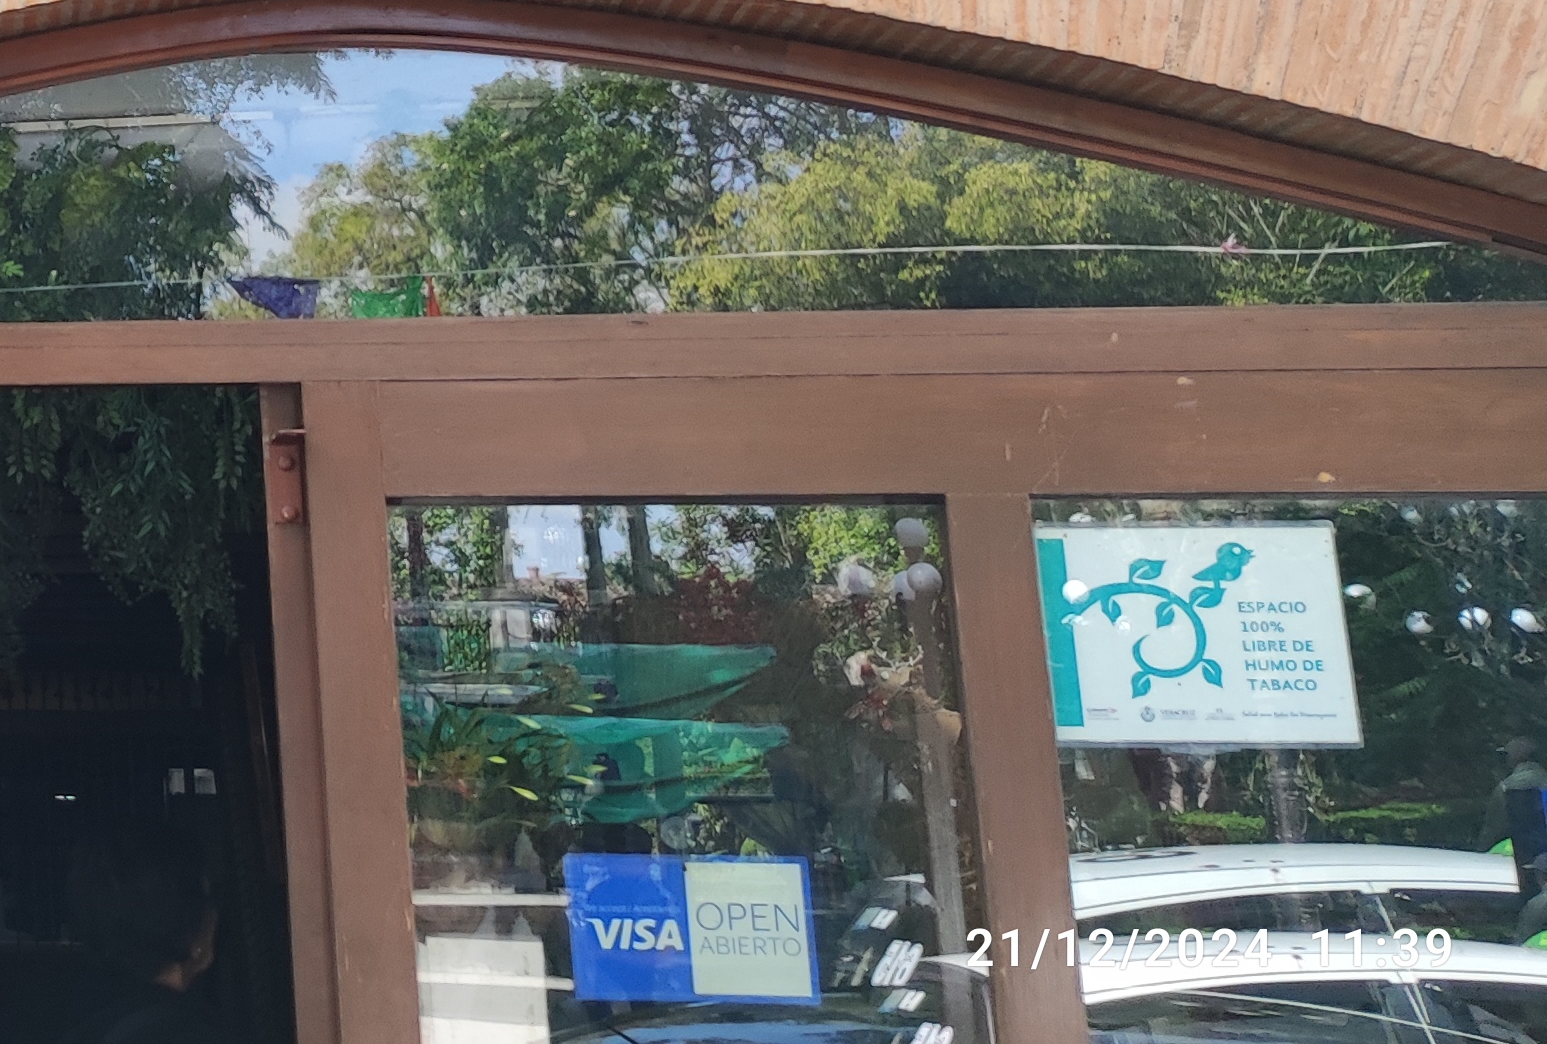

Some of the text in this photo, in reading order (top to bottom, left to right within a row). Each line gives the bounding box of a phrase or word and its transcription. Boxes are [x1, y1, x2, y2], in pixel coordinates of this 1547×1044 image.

[1237, 601, 1307, 613] ESPACIO
[1240, 620, 1285, 633] 100%
[1242, 640, 1315, 652] LIBRE DE
[1244, 659, 1324, 672] HUMO DE
[1246, 678, 1318, 691] TABACO
[695, 901, 800, 933] OPEN
[585, 917, 684, 952] VISA
[699, 936, 802, 957] ABIERTO
